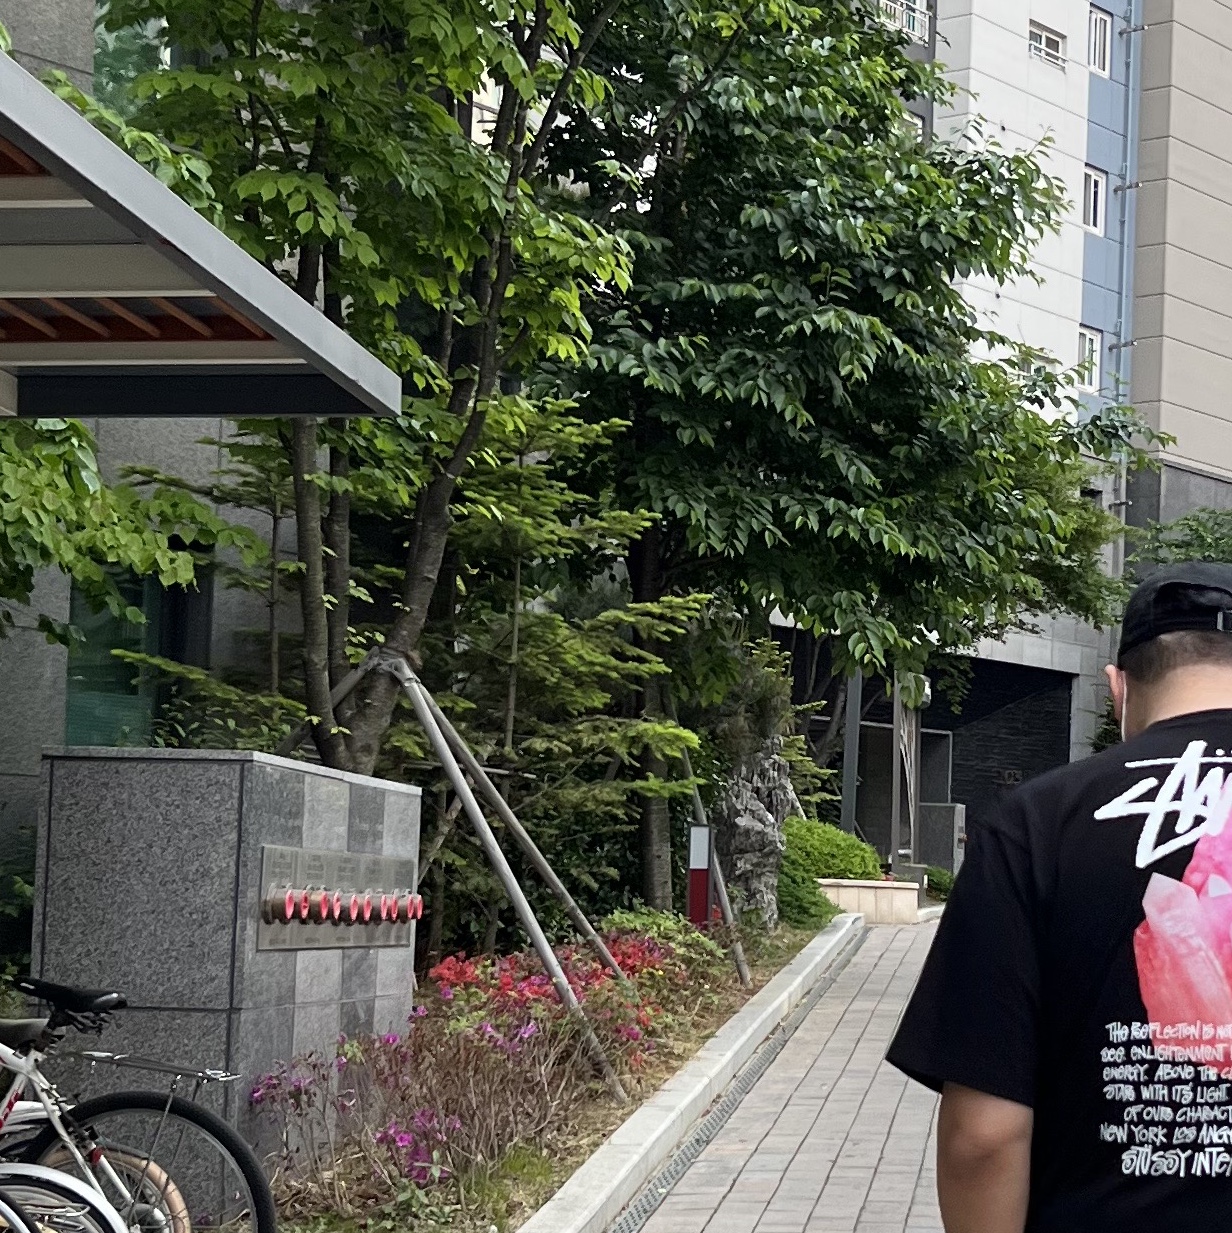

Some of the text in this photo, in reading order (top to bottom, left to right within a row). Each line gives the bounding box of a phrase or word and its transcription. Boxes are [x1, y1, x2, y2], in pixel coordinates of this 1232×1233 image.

[1105, 1021, 1130, 1043] THE
[1154, 1063, 1195, 1082] ABOVE
[1140, 1083, 1169, 1102] WITH
[1100, 1122, 1128, 1143] NEW
[1130, 1124, 1168, 1146] YORK
[1172, 1126, 1198, 1145] LOS
